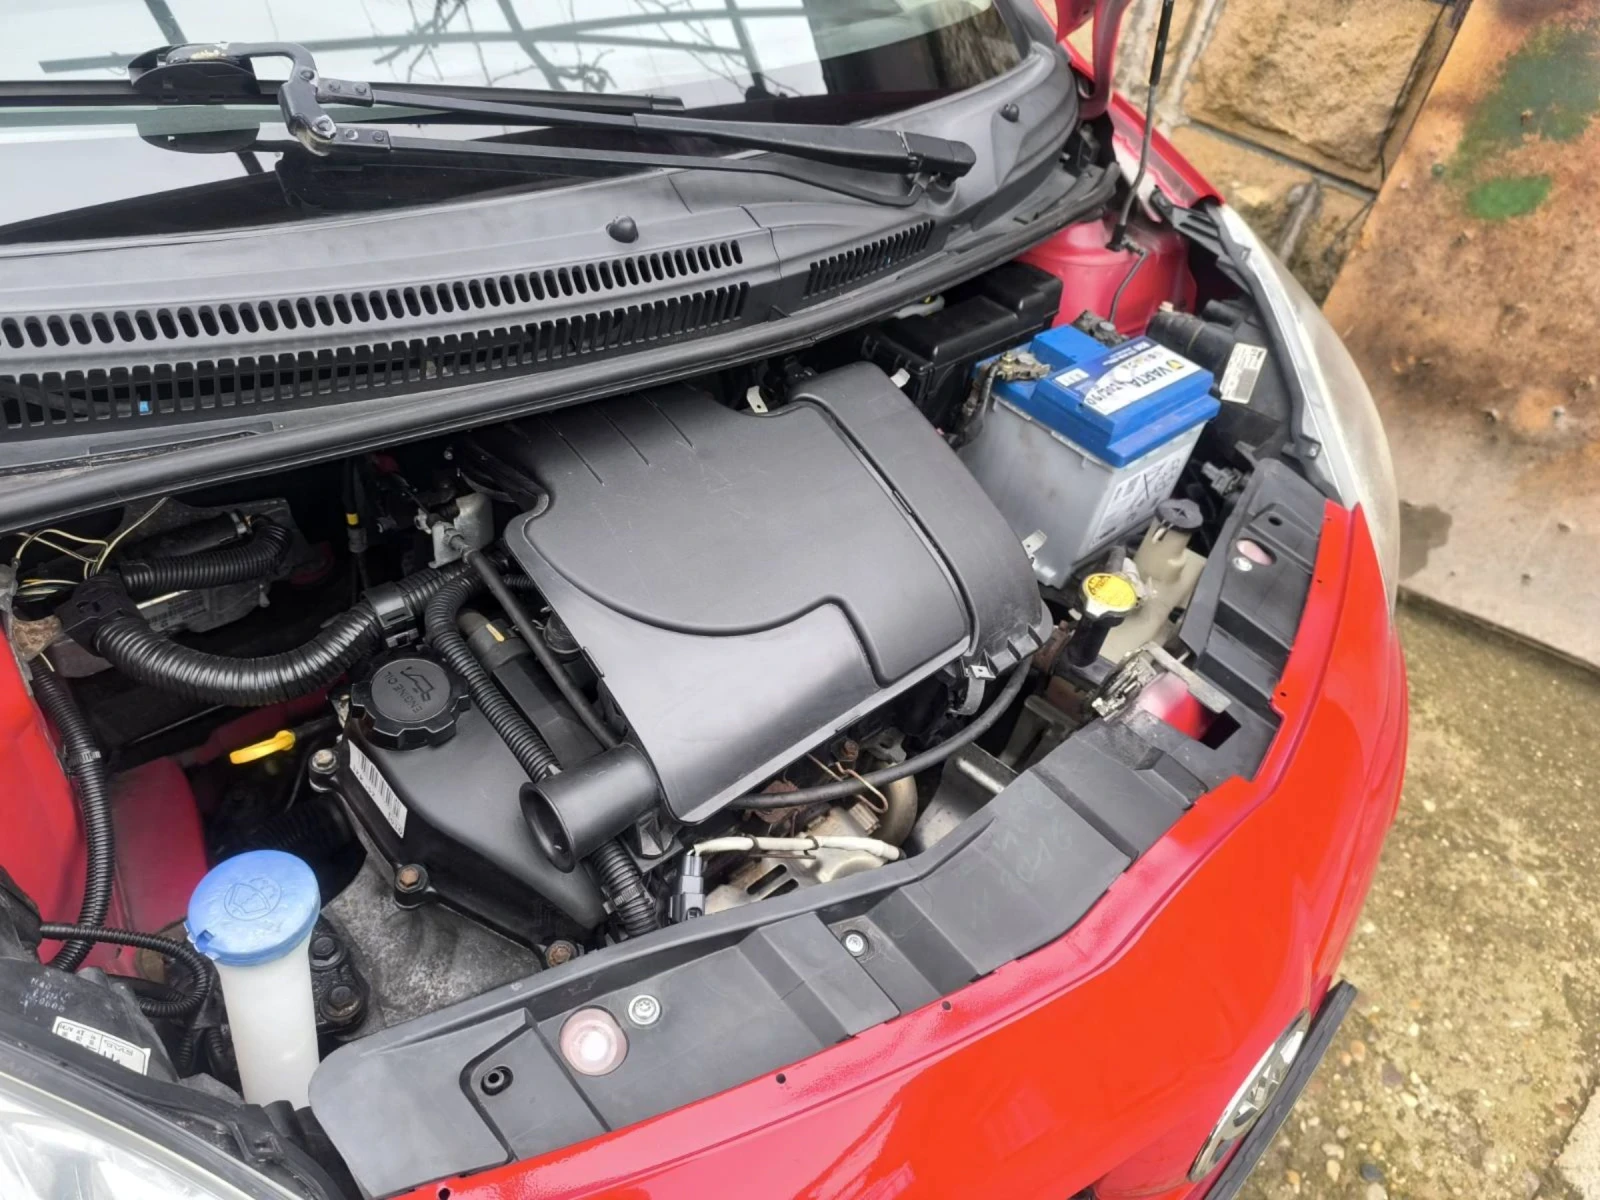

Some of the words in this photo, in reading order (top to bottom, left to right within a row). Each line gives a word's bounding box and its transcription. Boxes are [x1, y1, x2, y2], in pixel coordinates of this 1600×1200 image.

[1131, 366, 1172, 388] VARTA
[385, 670, 398, 685] OIL
[392, 683, 423, 714] ENGINE
